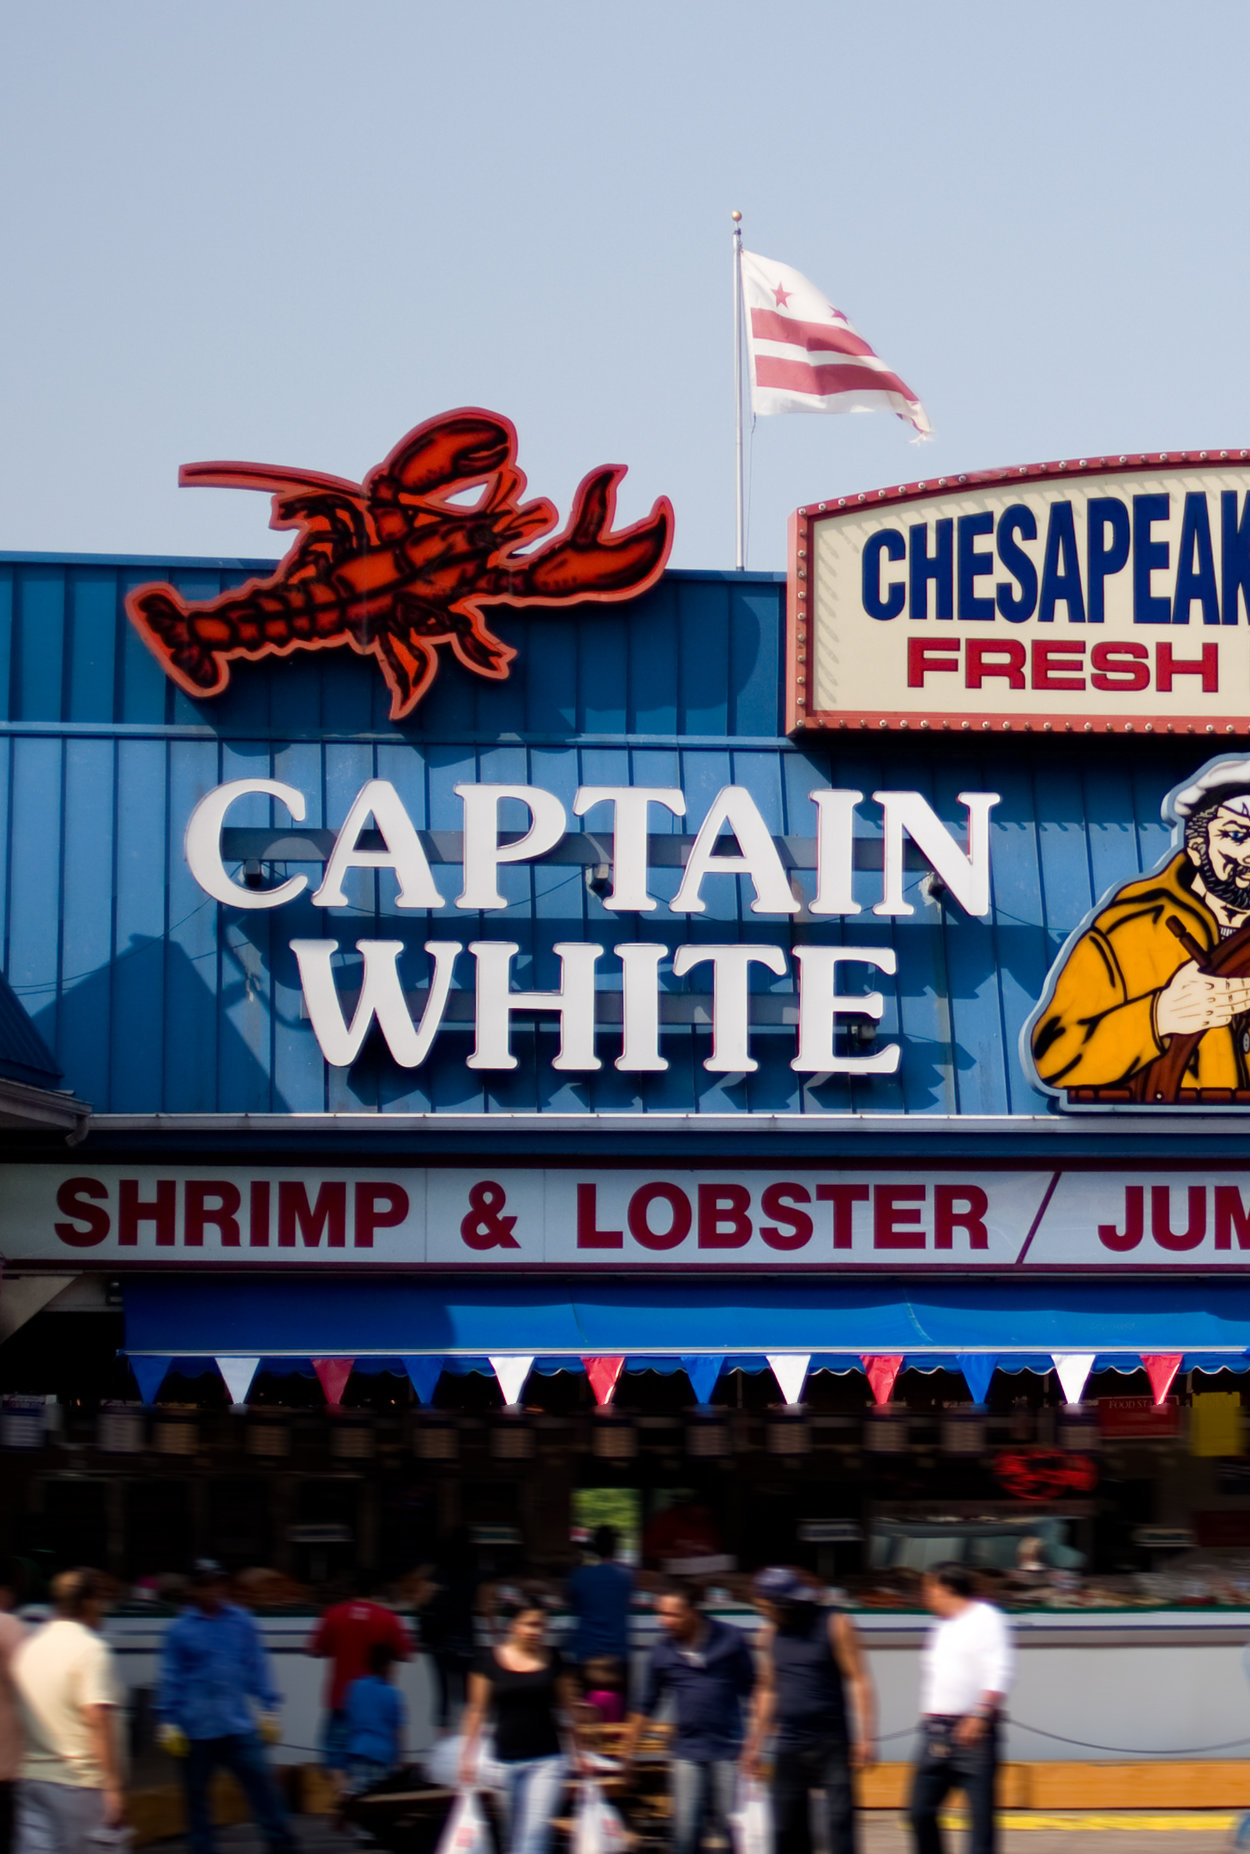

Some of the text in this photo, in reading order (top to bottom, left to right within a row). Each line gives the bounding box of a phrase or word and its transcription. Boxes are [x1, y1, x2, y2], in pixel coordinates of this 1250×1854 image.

[906, 636, 1220, 693] FRESH
[185, 777, 1002, 917] CAPTAIN
[288, 938, 902, 1074] WHITE
[54, 1179, 410, 1250] SHRIMP
[459, 1180, 522, 1251] &
[576, 1180, 990, 1252] LOBSTER
